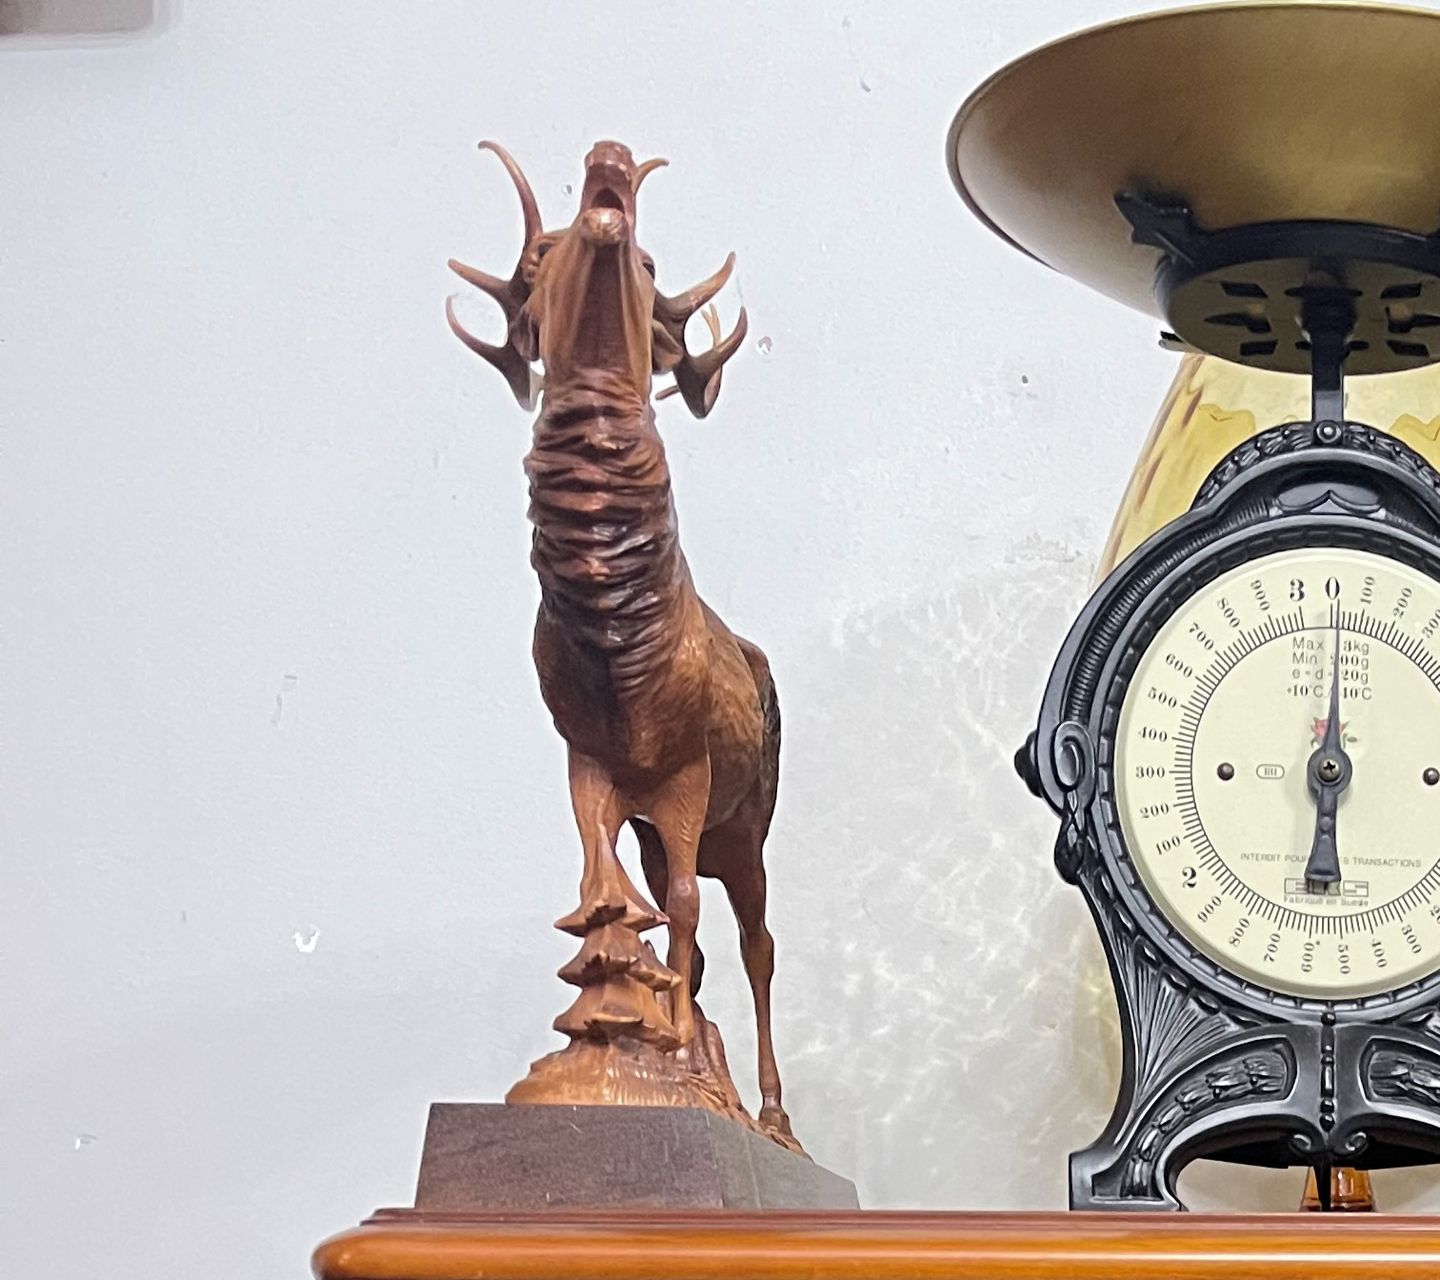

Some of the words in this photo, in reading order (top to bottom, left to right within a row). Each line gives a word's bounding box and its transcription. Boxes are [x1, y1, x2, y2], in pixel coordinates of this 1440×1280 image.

[1250, 579, 1271, 612] 900
[1289, 579, 1305, 601] 3
[1325, 576, 1340, 600] 0
[1360, 576, 1376, 605] 100
[1216, 597, 1241, 629] 800
[1393, 587, 1413, 618] 200
[1188, 623, 1215, 651] 700
[1292, 636, 1325, 650] Max
[1166, 653, 1193, 679] 600
[1292, 651, 1318, 665] Min
[1147, 689, 1177, 709] 500
[1137, 727, 1168, 744] 400
[1136, 766, 1166, 779] 300
[1139, 803, 1169, 819] 200
[1155, 836, 1181, 855] 100
[1353, 857, 1422, 868] TRANSACTIONS
[1182, 866, 1197, 889] 2
[1197, 894, 1222, 923] 900
[1229, 917, 1250, 948] 800
[1401, 924, 1422, 955] 300
[1264, 933, 1281, 963] 700
[1301, 942, 1315, 973] 600
[1338, 944, 1349, 975] 500
